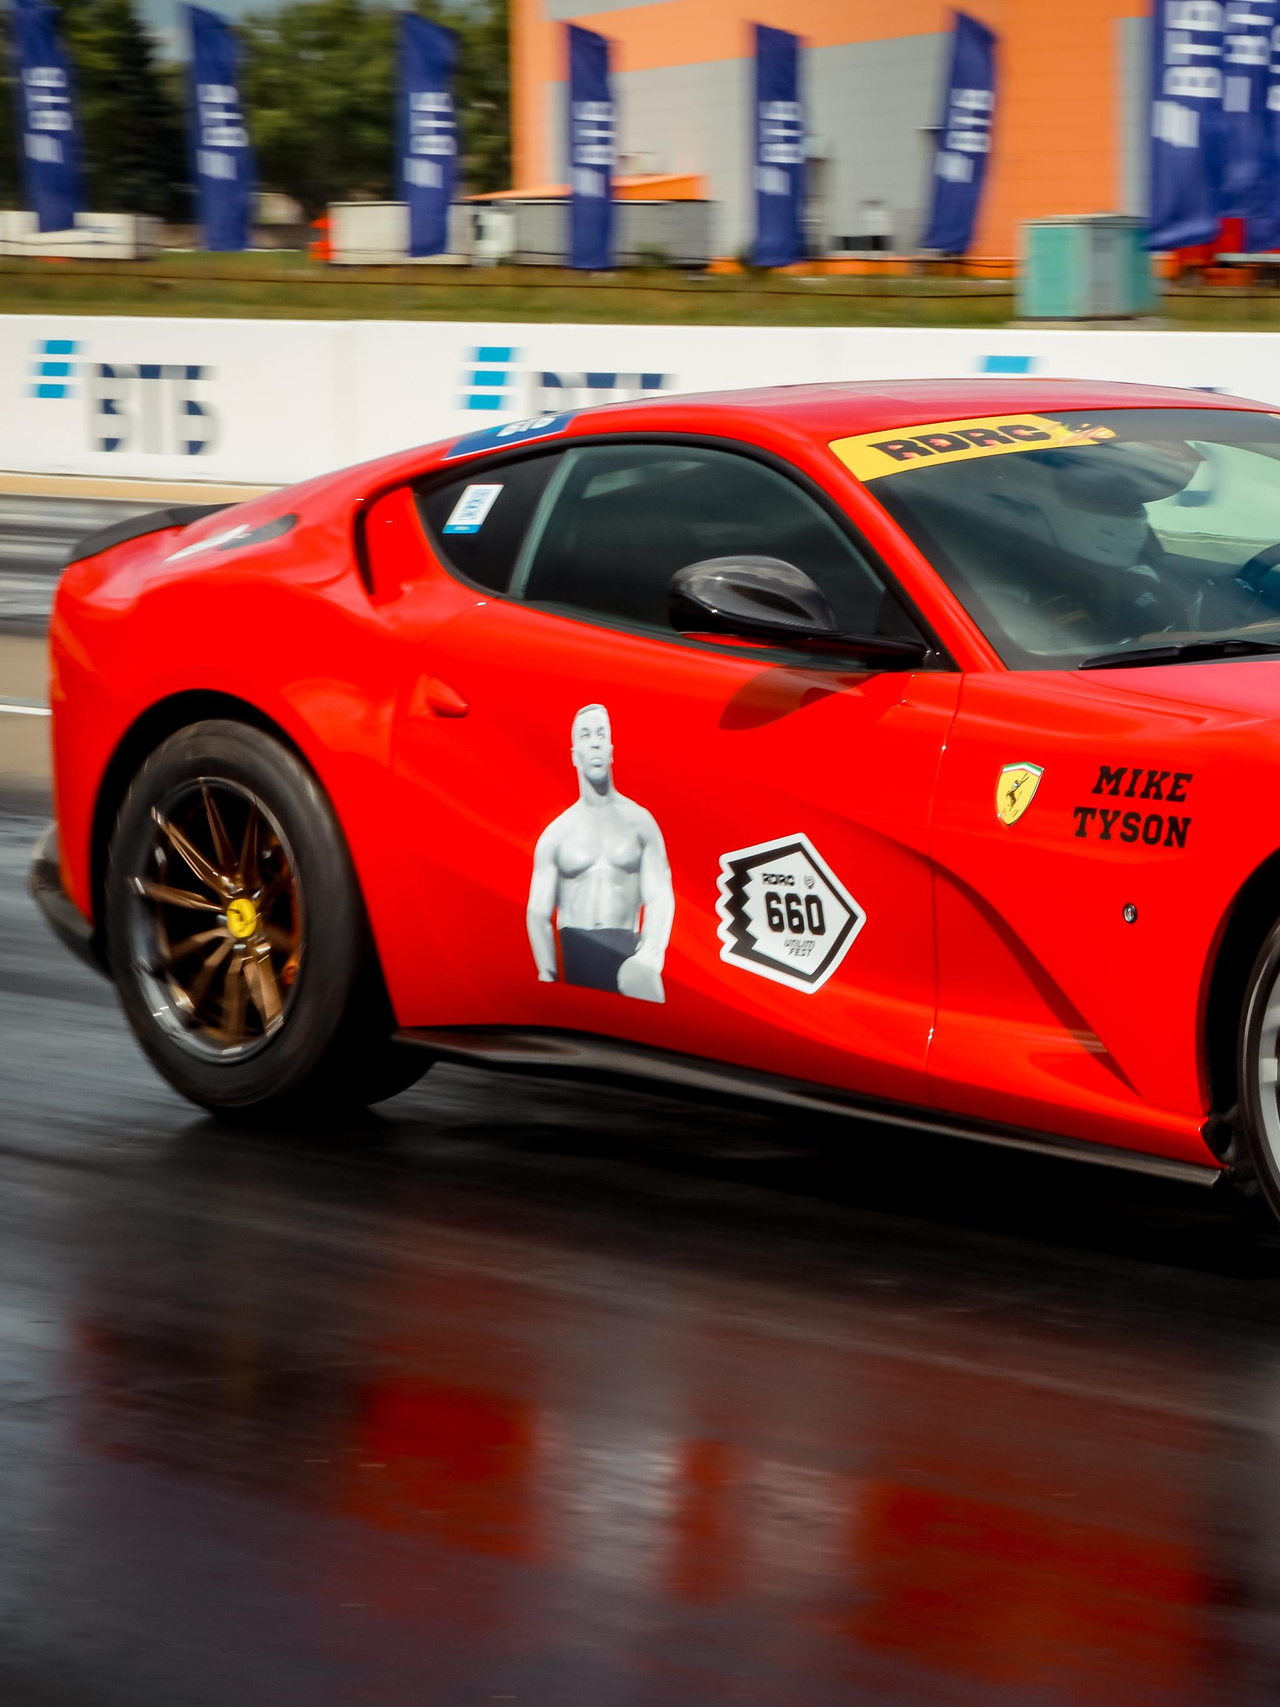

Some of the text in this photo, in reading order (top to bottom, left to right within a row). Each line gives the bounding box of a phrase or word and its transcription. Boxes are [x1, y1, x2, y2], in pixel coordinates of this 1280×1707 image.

[90, 363, 217, 456] ВТБ
[866, 424, 1051, 461] RDRC
[1091, 765, 1194, 803] MIKE
[1073, 806, 1192, 849] TYSON
[765, 892, 826, 935] 660
